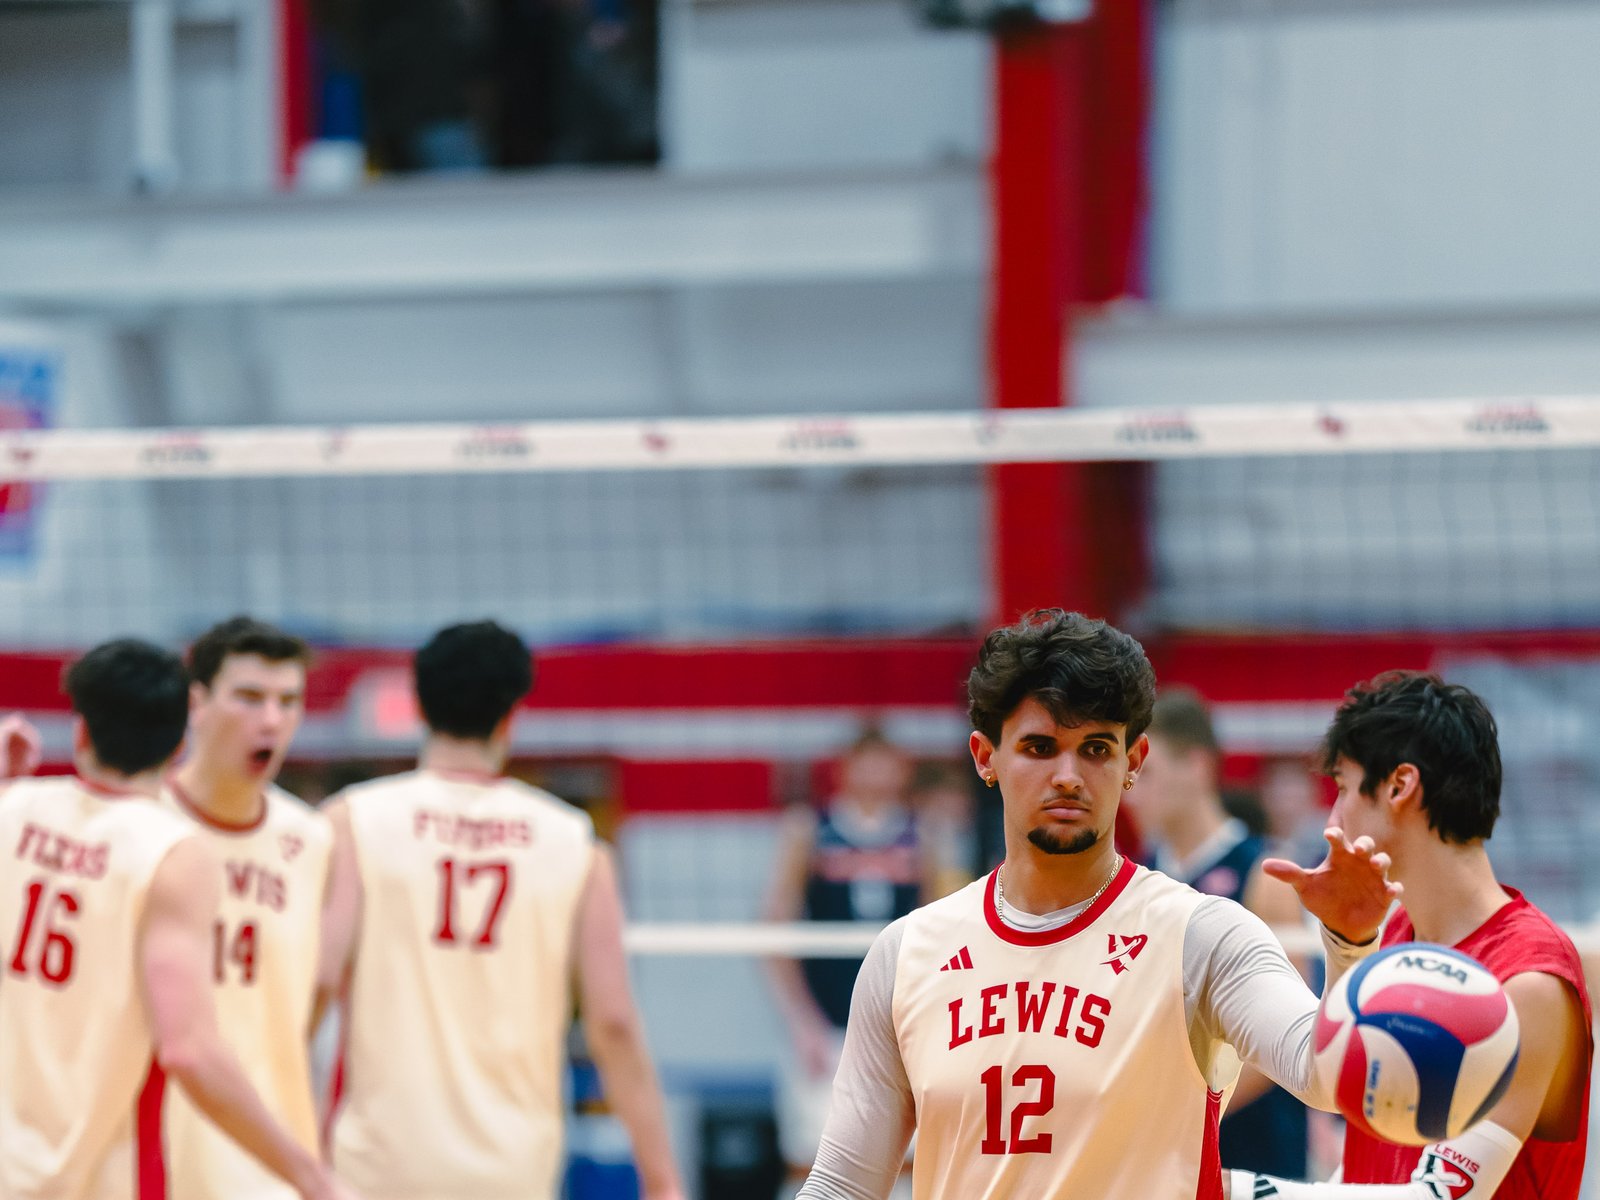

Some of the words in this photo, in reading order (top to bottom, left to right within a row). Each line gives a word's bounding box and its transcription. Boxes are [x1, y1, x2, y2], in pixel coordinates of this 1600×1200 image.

[8, 877, 81, 986] 16
[434, 855, 514, 950] 17
[209, 917, 258, 986] 14
[1395, 955, 1468, 985] NCAA
[947, 980, 1113, 1051] LEWIS
[979, 1064, 1057, 1156] 12
[1434, 1143, 1480, 1174] LEWIS
